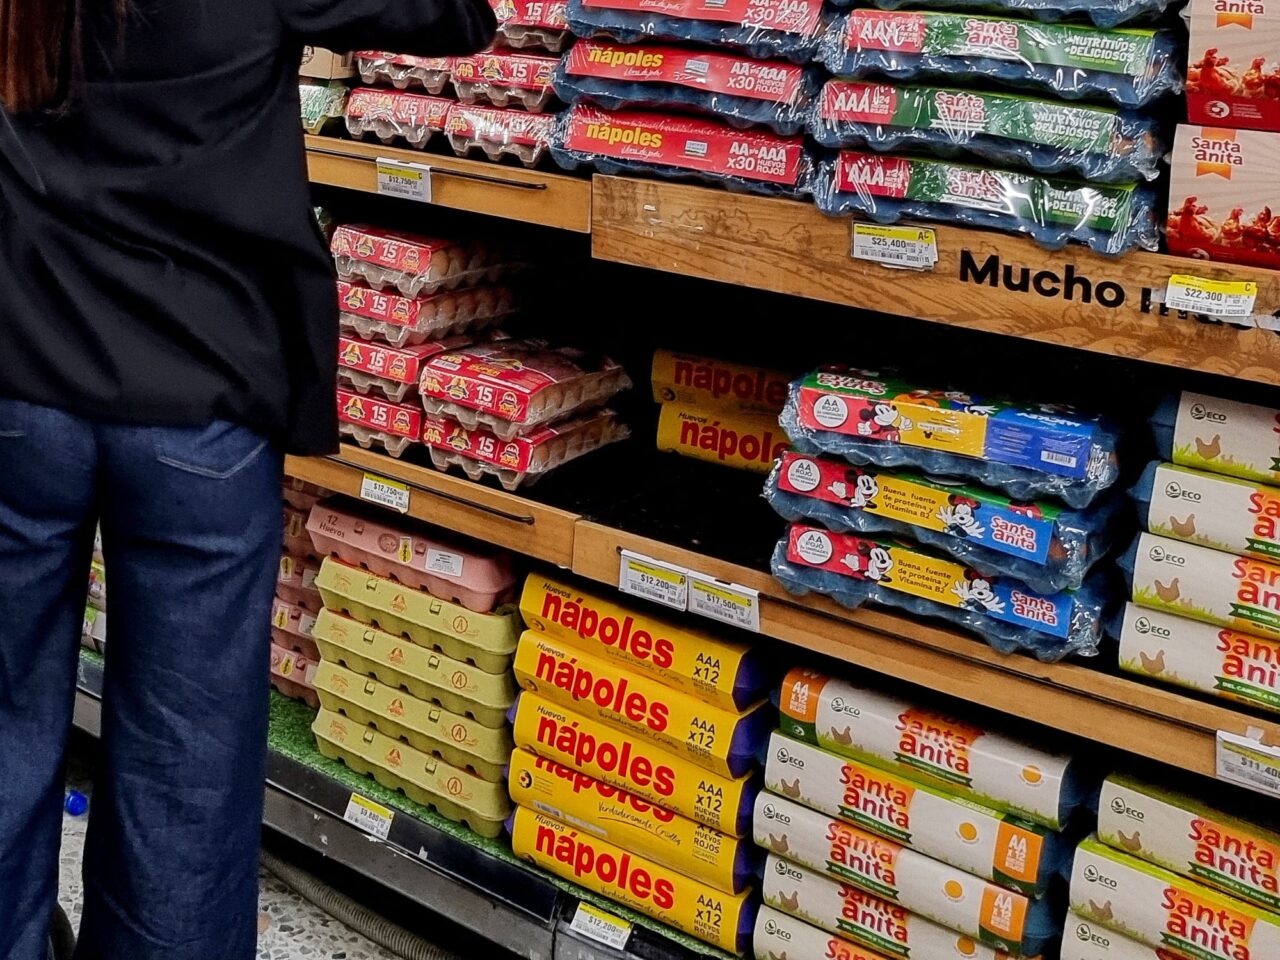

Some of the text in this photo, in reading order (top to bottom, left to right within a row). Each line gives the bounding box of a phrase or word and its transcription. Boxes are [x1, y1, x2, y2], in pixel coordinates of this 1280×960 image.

[525, 3, 543, 16] 15
[1214, 0, 1265, 14] anita
[588, 47, 663, 67] nápoles
[586, 123, 662, 148] nápoles
[1191, 137, 1241, 153] Santa
[727, 156, 755, 171] x30
[1195, 150, 1243, 165] anita
[756, 166, 785, 176] ROJOS
[871, 236, 907, 249] $25,400
[382, 243, 398, 259] 15
[959, 249, 1126, 309] Mucho
[1184, 287, 1223, 302] $22,300
[372, 295, 387, 311] 15
[370, 351, 385, 368] 15
[476, 385, 493, 402] 15
[371, 405, 387, 421] 15
[1206, 410, 1227, 422] ECO
[479, 436, 495, 453] 15
[883, 486, 936, 505] Buena fuente
[884, 502, 930, 519] Vitamina B2
[327, 514, 338, 525] 12
[320, 522, 345, 538] Huevos
[991, 516, 1035, 540] Santa
[994, 529, 1036, 552] anita
[925, 565, 951, 579] fuente
[640, 574, 669, 590] $12,200
[706, 593, 737, 610] $17,500
[1011, 591, 1055, 614] Santa
[1014, 603, 1057, 626] anita
[541, 592, 674, 669] nápoles
[1151, 625, 1171, 638] ECO
[696, 653, 720, 669] AAA
[693, 668, 719, 683] x12
[535, 652, 670, 733] nápoles
[844, 705, 861, 717] ECO
[691, 717, 716, 735] AAA
[688, 732, 715, 748] x12
[536, 716, 676, 796] nápoles
[899, 733, 970, 774] anita
[789, 756, 805, 768] ECO
[697, 781, 723, 799] AAA
[839, 765, 908, 808] Santa
[696, 795, 722, 812] x12
[843, 786, 910, 830] anita
[694, 805, 720, 819] HUEVOS
[776, 813, 791, 824] ECO
[1126, 807, 1144, 820] ECO
[535, 815, 566, 832] Huevos
[694, 830, 721, 845] HUEVOS
[825, 821, 894, 865] Santa
[1188, 819, 1274, 869] Santa
[694, 838, 721, 854] ROJOS
[535, 826, 675, 910] nápoles
[830, 844, 896, 887] anita
[1195, 843, 1279, 893] anita
[787, 868, 803, 880] ECO
[1098, 874, 1117, 888] ECO
[696, 894, 722, 913] AAA
[695, 909, 722, 927] x12
[841, 899, 908, 943] anita
[1161, 888, 1246, 939] Santa
[693, 919, 720, 934] HUEVOS
[776, 929, 792, 941] ECO
[1091, 933, 1110, 947] ECO
